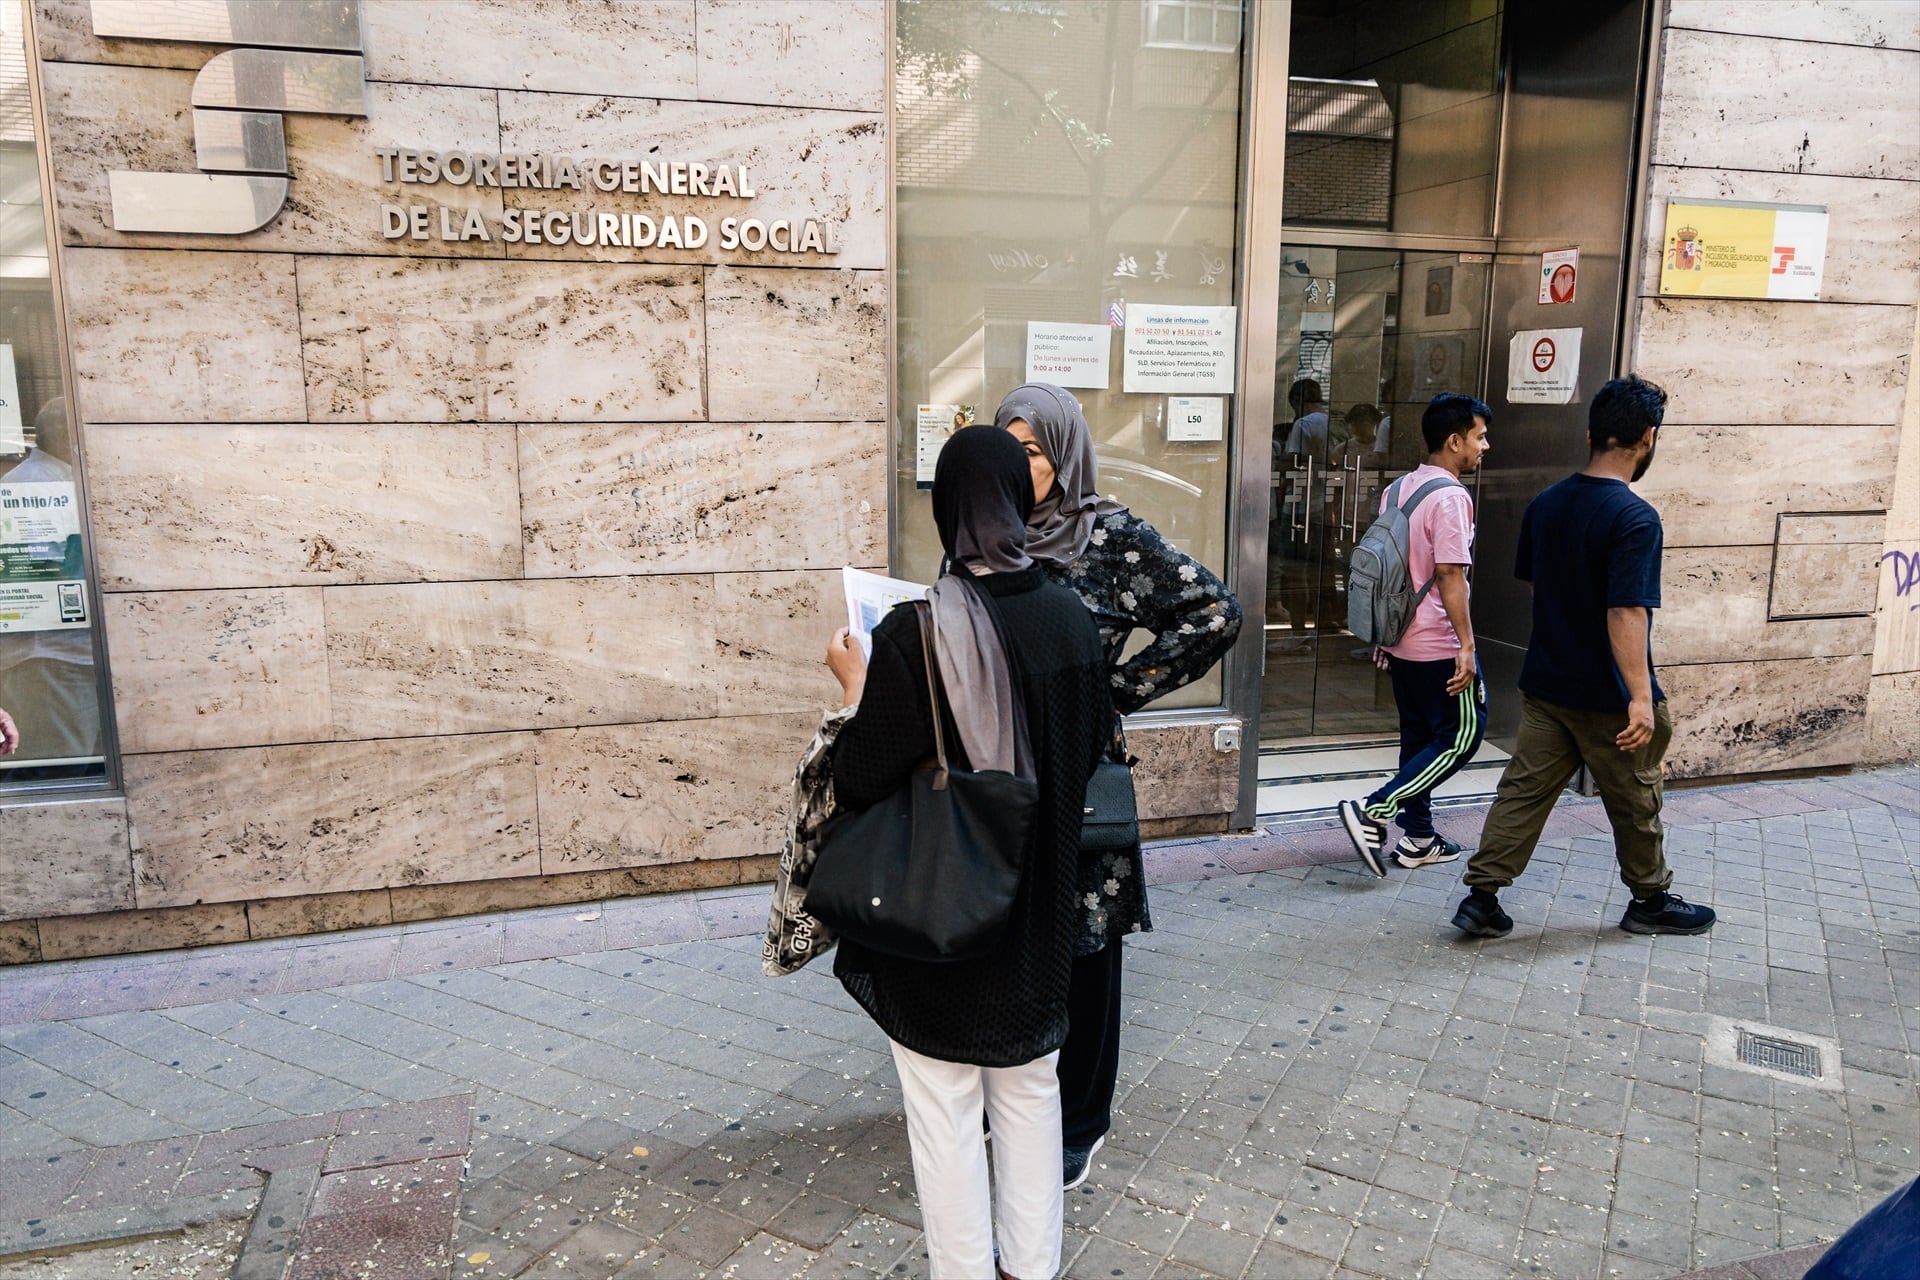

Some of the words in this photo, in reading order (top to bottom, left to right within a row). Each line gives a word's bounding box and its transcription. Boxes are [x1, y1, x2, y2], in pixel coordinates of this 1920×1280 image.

[377, 149, 581, 190] TESORERIA
[592, 157, 756, 199] GENERAL
[381, 204, 430, 241] DE
[439, 206, 491, 242] LA
[501, 208, 709, 249] SEGURIDAD
[719, 216, 840, 255] SOCIAL
[1034, 333, 1058, 341] Horario
[1059, 334, 1087, 342] atención
[1187, 415, 1202, 424] L50
[3, 499, 20, 509] un
[22, 495, 69, 509] hijo/a?
